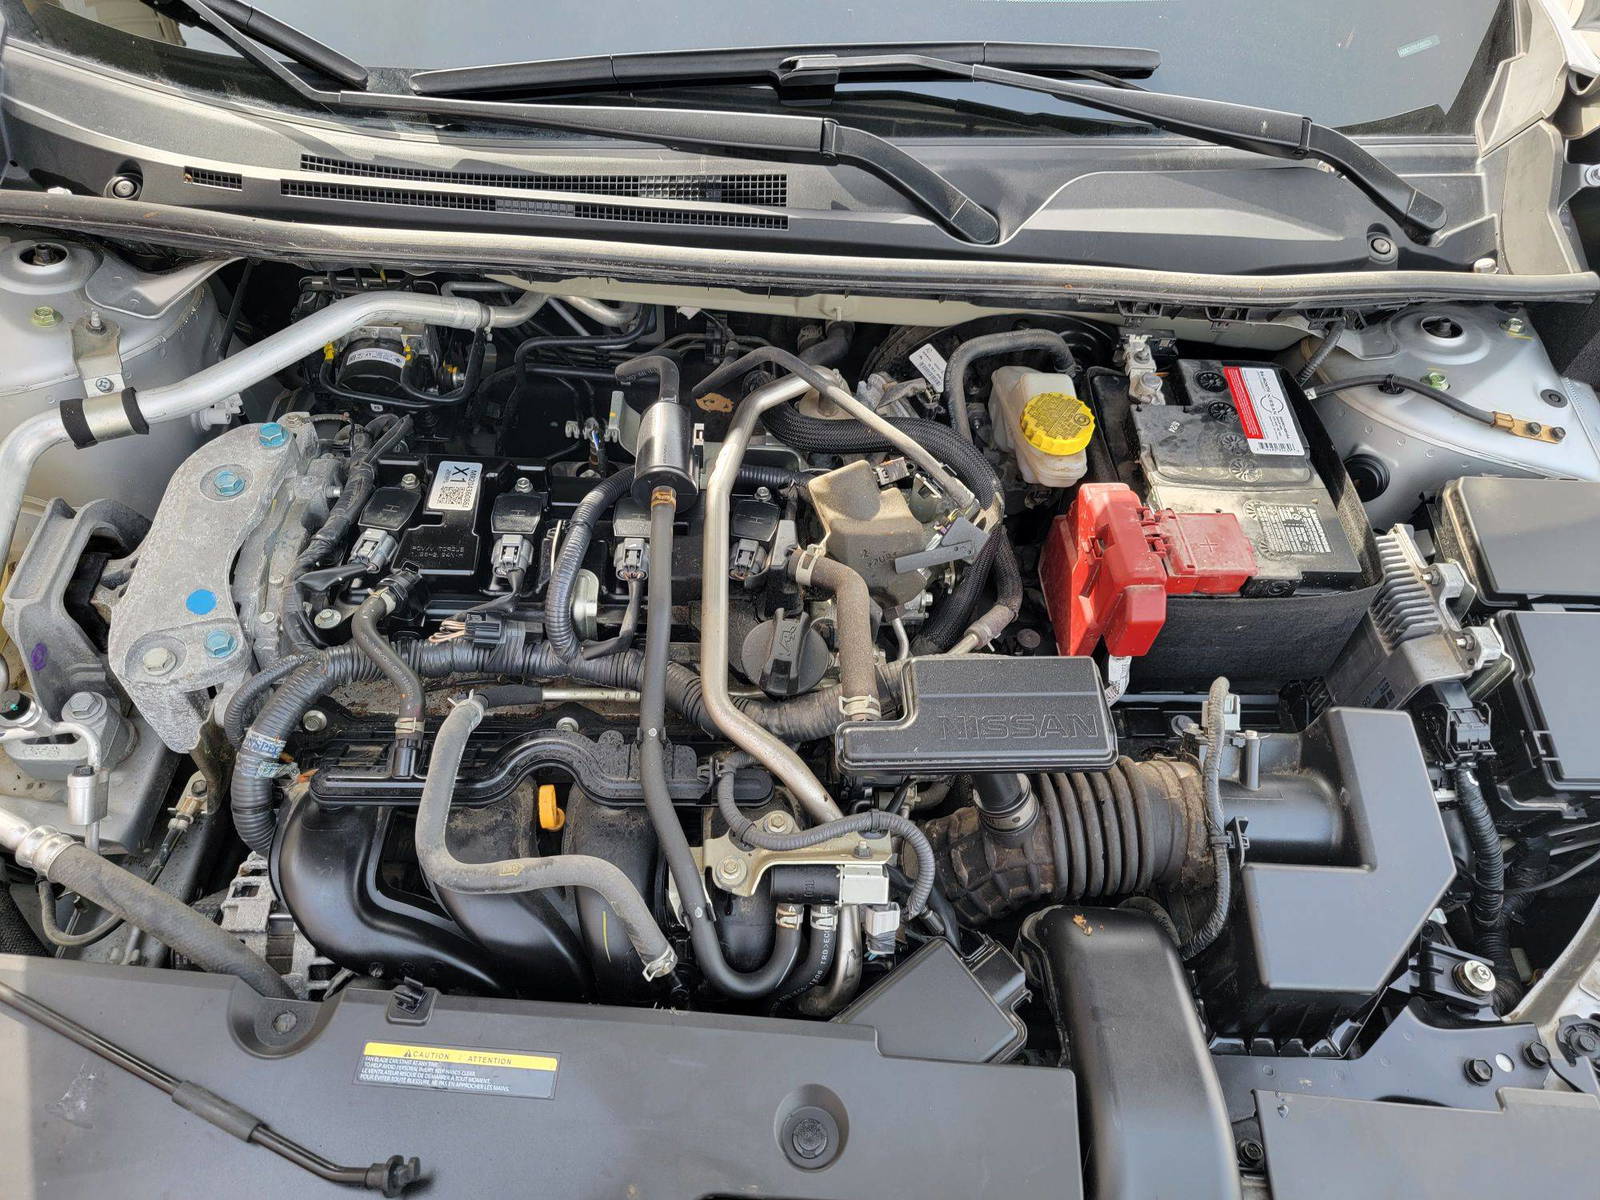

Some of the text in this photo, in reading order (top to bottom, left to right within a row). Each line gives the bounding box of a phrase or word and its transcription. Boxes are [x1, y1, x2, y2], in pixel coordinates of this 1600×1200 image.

[450, 466, 470, 483] X1
[938, 713, 1099, 740] NISSAN
[413, 1050, 512, 1065] CAUTION ATTENTION
